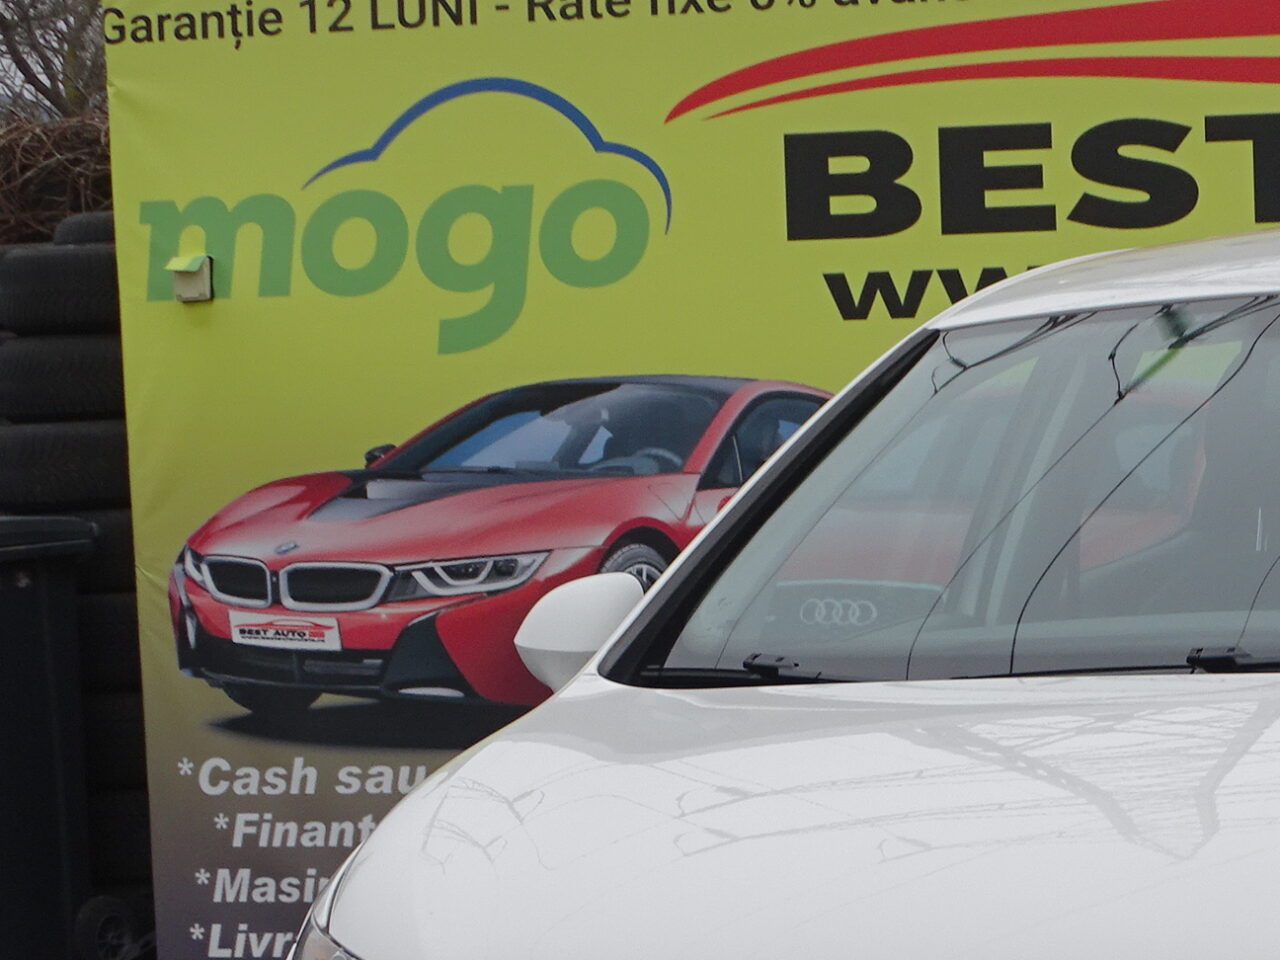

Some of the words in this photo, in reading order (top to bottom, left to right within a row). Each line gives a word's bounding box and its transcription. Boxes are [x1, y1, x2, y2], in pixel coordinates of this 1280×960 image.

[103, 1, 284, 50] Garanție
[299, 0, 354, 34] 12
[370, 0, 478, 30] LUNI
[139, 178, 651, 356] mogo
[335, 764, 428, 795] sau
[194, 868, 331, 903] Masi
